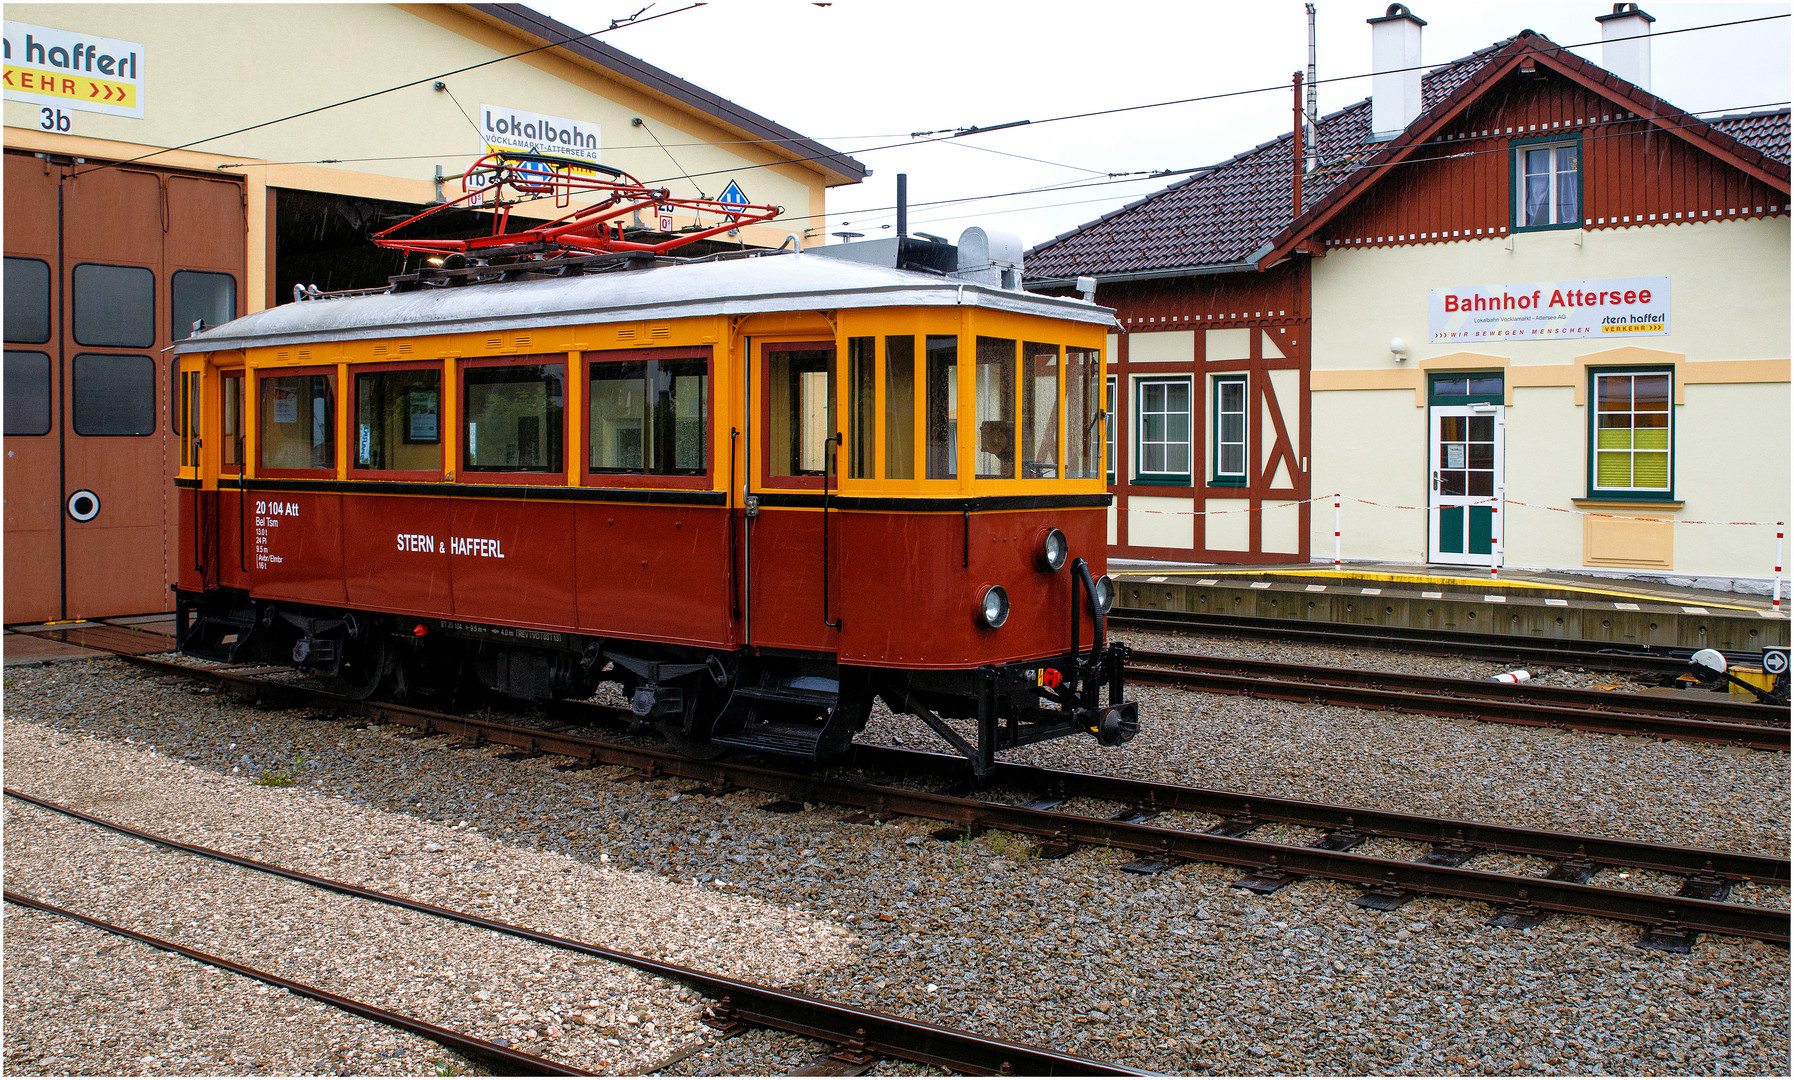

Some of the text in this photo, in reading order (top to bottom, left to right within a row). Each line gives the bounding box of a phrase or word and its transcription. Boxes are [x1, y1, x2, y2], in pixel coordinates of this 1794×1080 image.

[26, 34, 136, 79] hafferl
[41, 107, 71, 132] 3b
[486, 110, 597, 149] Lokalbahn
[587, 151, 597, 159] AG
[1444, 289, 1652, 312] Bahnhof Attersee
[1601, 313, 1665, 324] stern hafferl
[1531, 327, 1590, 335] MENSCHEN
[256, 500, 299, 516] 20 104 Att
[256, 516, 279, 527] Bel Tsm
[256, 536, 262, 544] 24
[397, 533, 505, 558] STERN & HAFFERL
